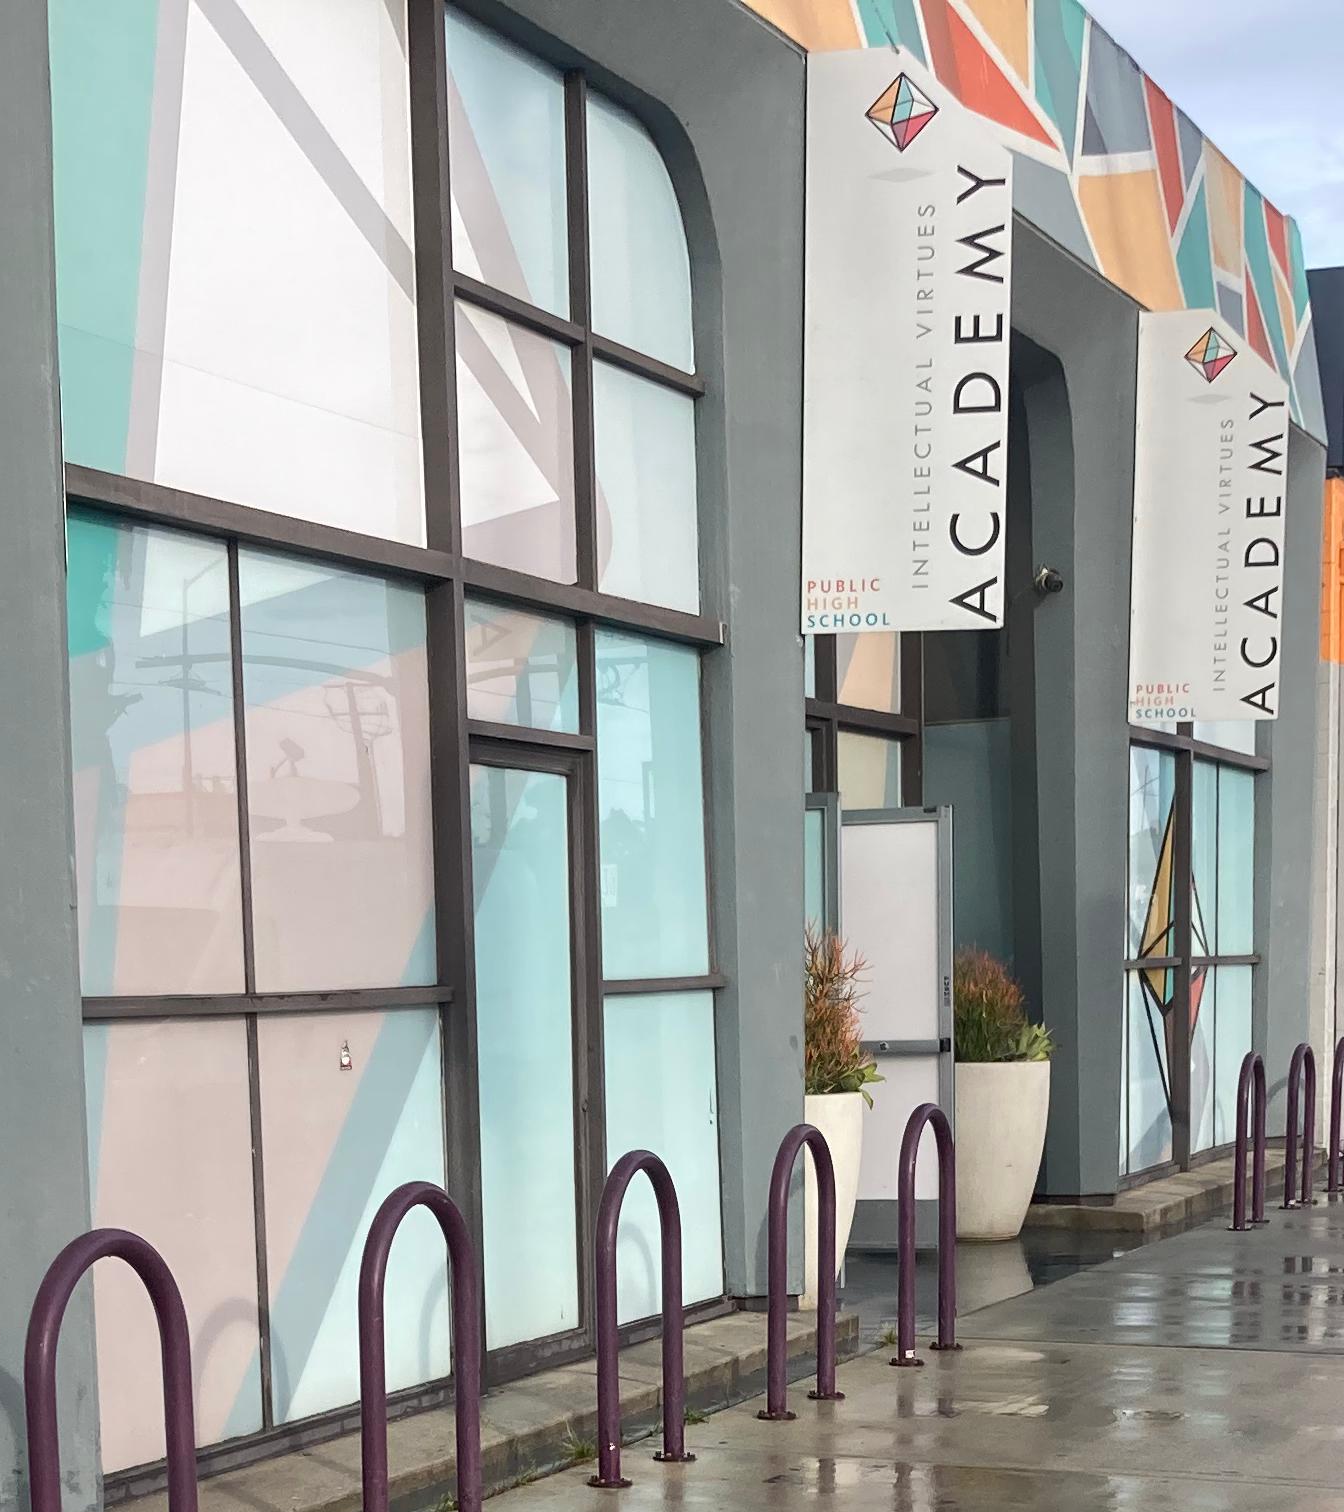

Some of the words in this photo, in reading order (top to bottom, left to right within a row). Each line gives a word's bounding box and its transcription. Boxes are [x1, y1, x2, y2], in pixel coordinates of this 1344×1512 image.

[916, 204, 936, 339] VIRTUES
[948, 165, 1006, 623] ACADEMY
[912, 358, 933, 589] INTELLECTUAL
[1219, 419, 1235, 514] VIRTUES
[1239, 392, 1285, 715] ACADEMY
[807, 578, 881, 594] PUBLIC
[807, 596, 859, 611] HIGH
[1213, 528, 1231, 691] INTELLECTUAL
[807, 612, 890, 628] SCHOOL
[1136, 683, 1190, 694] PUBLIC
[1136, 696, 1174, 706] HIGH
[1136, 707, 1196, 719] SCHOOL
